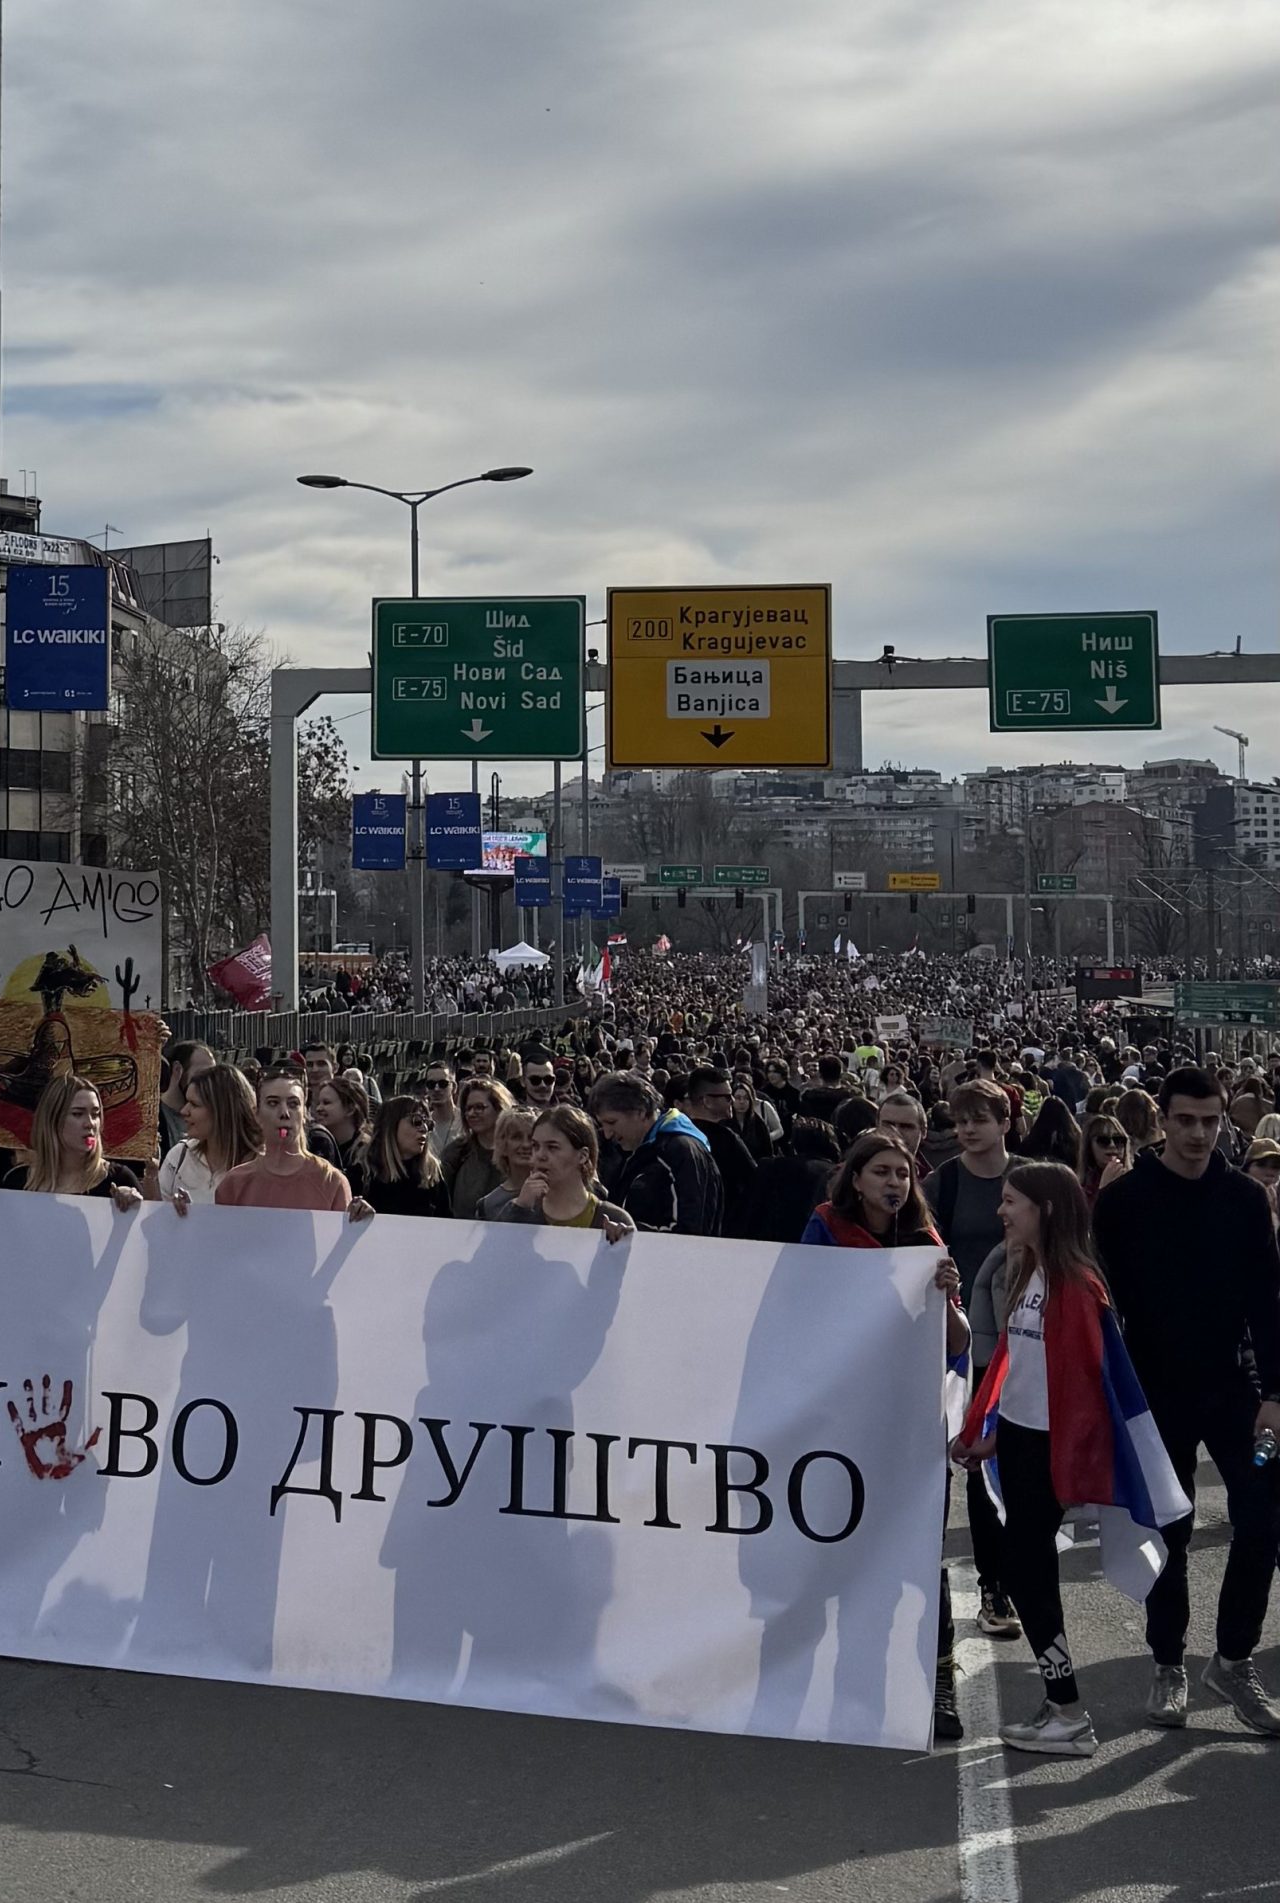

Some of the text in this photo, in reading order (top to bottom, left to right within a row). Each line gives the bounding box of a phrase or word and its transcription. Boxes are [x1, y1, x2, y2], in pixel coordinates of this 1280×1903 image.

[48, 575, 70, 596] 15
[486, 610, 531, 628] Шид
[679, 606, 809, 628] Крагујевац
[13, 630, 35, 644] LC
[398, 626, 443, 643] E-70
[632, 620, 668, 638] 200
[493, 635, 523, 658] Šid
[682, 632, 807, 654] Kragujevac
[1081, 632, 1133, 651] Ниш
[454, 663, 563, 681] Нови Сад
[674, 667, 763, 686] Бањица
[1090, 660, 1128, 679] Niš
[398, 680, 442, 698] E-75
[461, 691, 561, 710] Novi Sad
[678, 694, 760, 716] Banjica
[1012, 693, 1065, 712] E-75
[355, 826, 368, 835] LC
[430, 826, 442, 835] LC
[40, 867, 160, 938] AMIGO
[270, 1407, 864, 1543] ДРУШТВО
